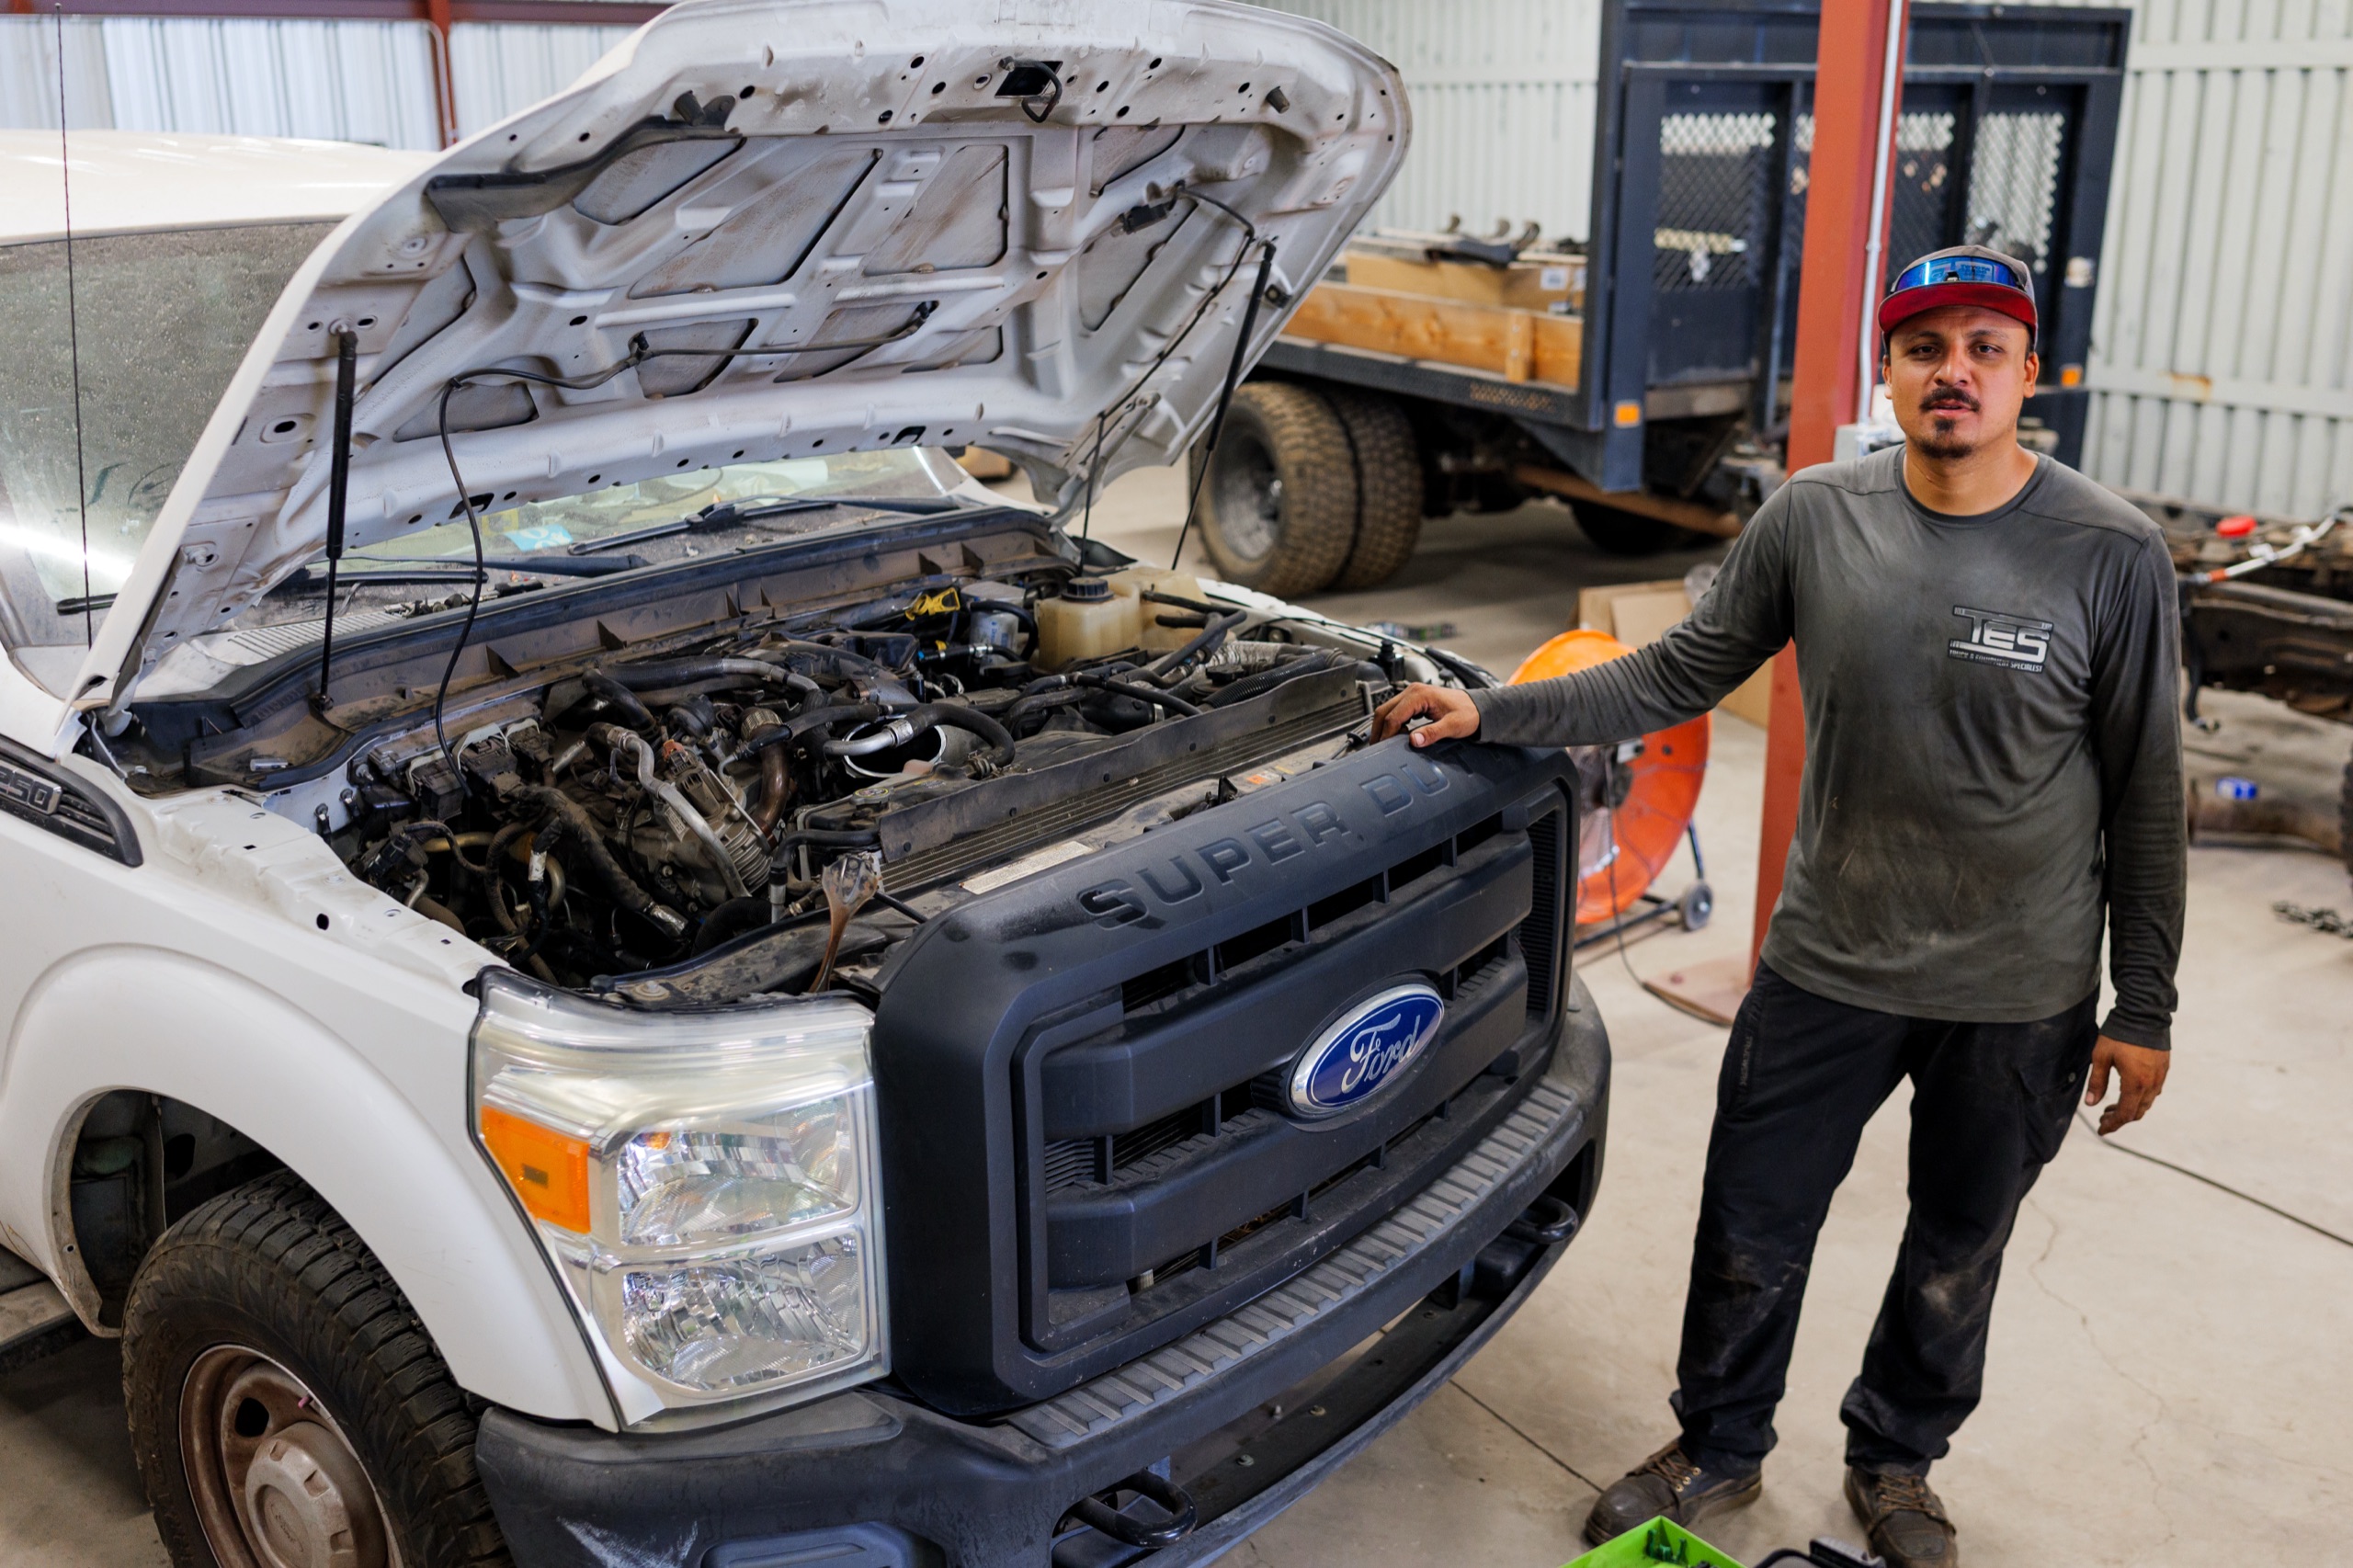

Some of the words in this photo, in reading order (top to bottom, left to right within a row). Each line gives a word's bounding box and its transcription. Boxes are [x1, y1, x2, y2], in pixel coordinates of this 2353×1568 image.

[1950, 608, 2052, 663] TES
[1076, 801, 1353, 930] SUPER
[1361, 739, 1506, 818] DUT
[1341, 1013, 1421, 1094] Ford
